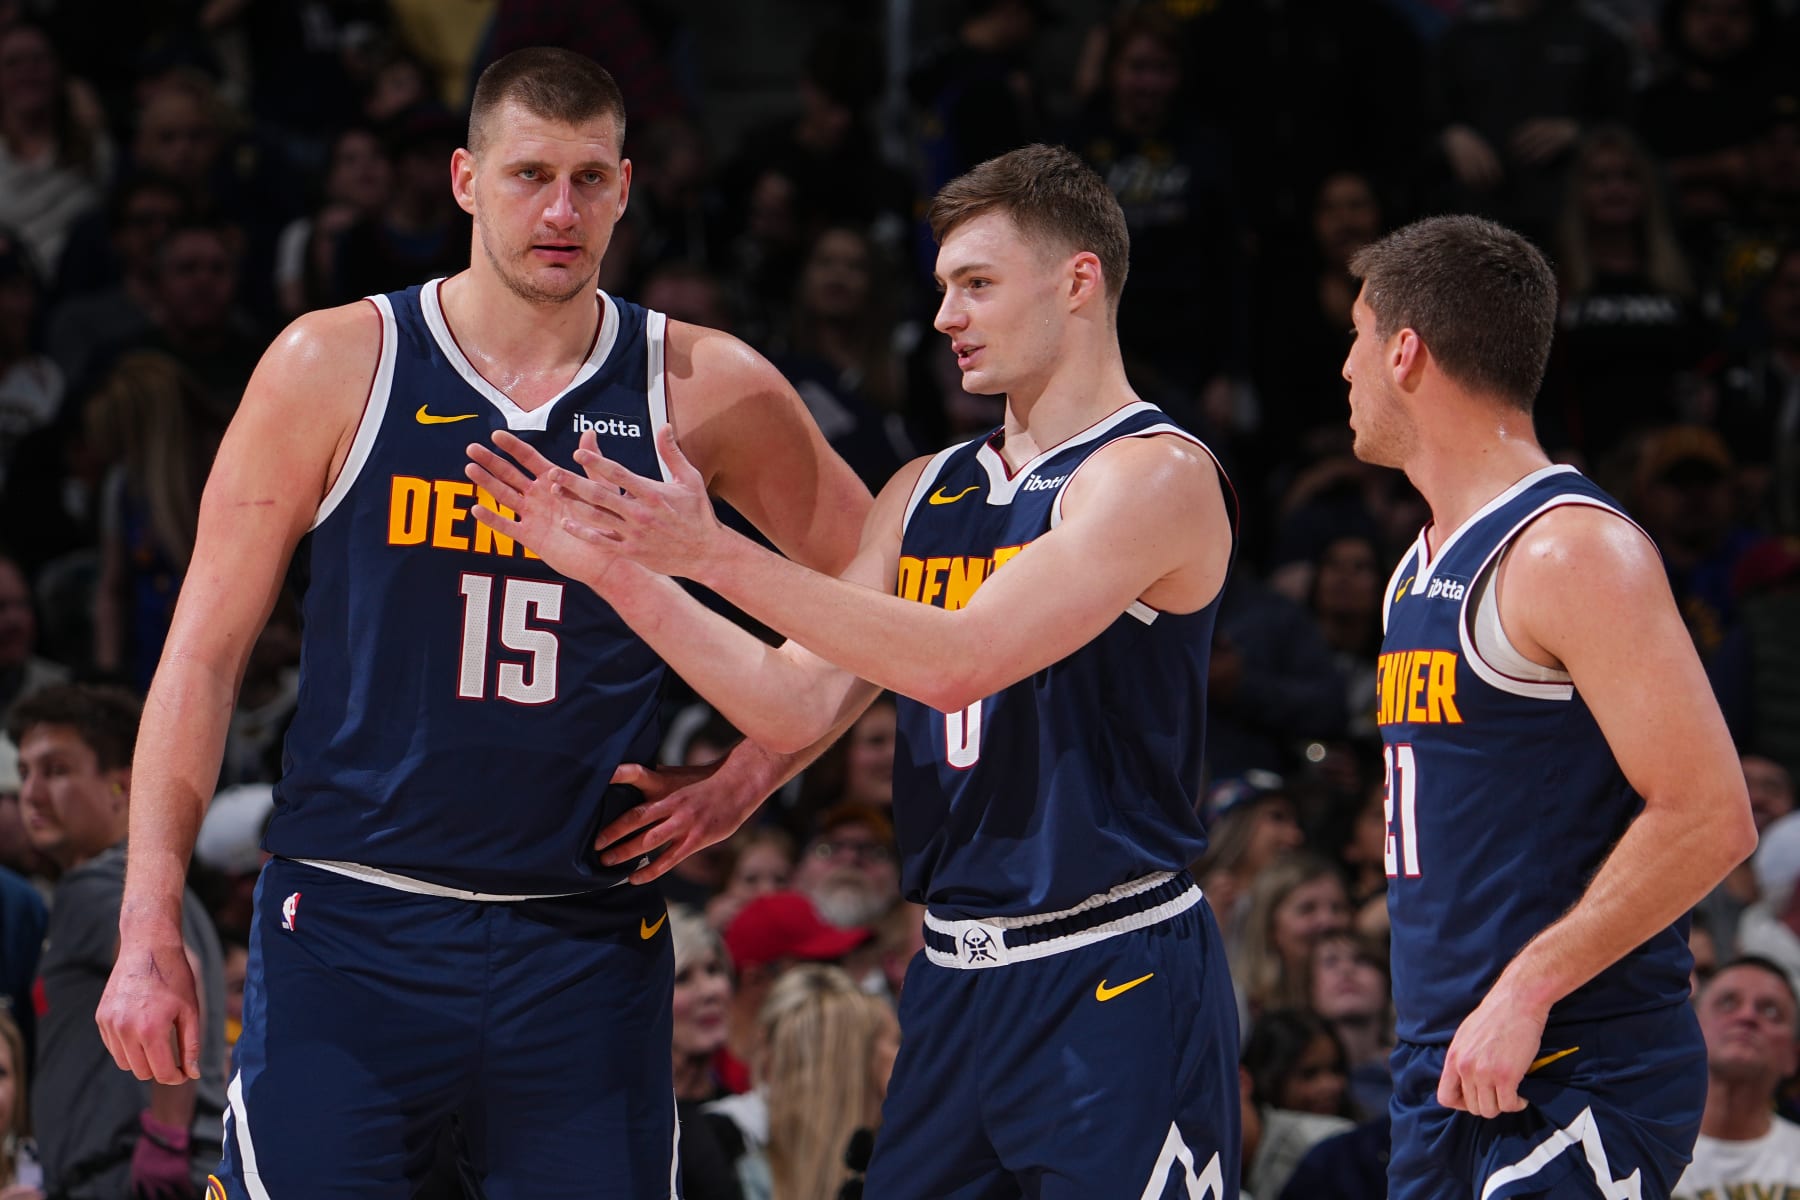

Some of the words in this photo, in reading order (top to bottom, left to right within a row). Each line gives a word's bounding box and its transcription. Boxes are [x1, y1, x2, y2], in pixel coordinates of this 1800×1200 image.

[574, 413, 641, 438] ibotta
[387, 474, 541, 560] DEN
[1023, 474, 1067, 491] ibott
[898, 541, 1032, 611] DEN
[456, 571, 566, 706] 15
